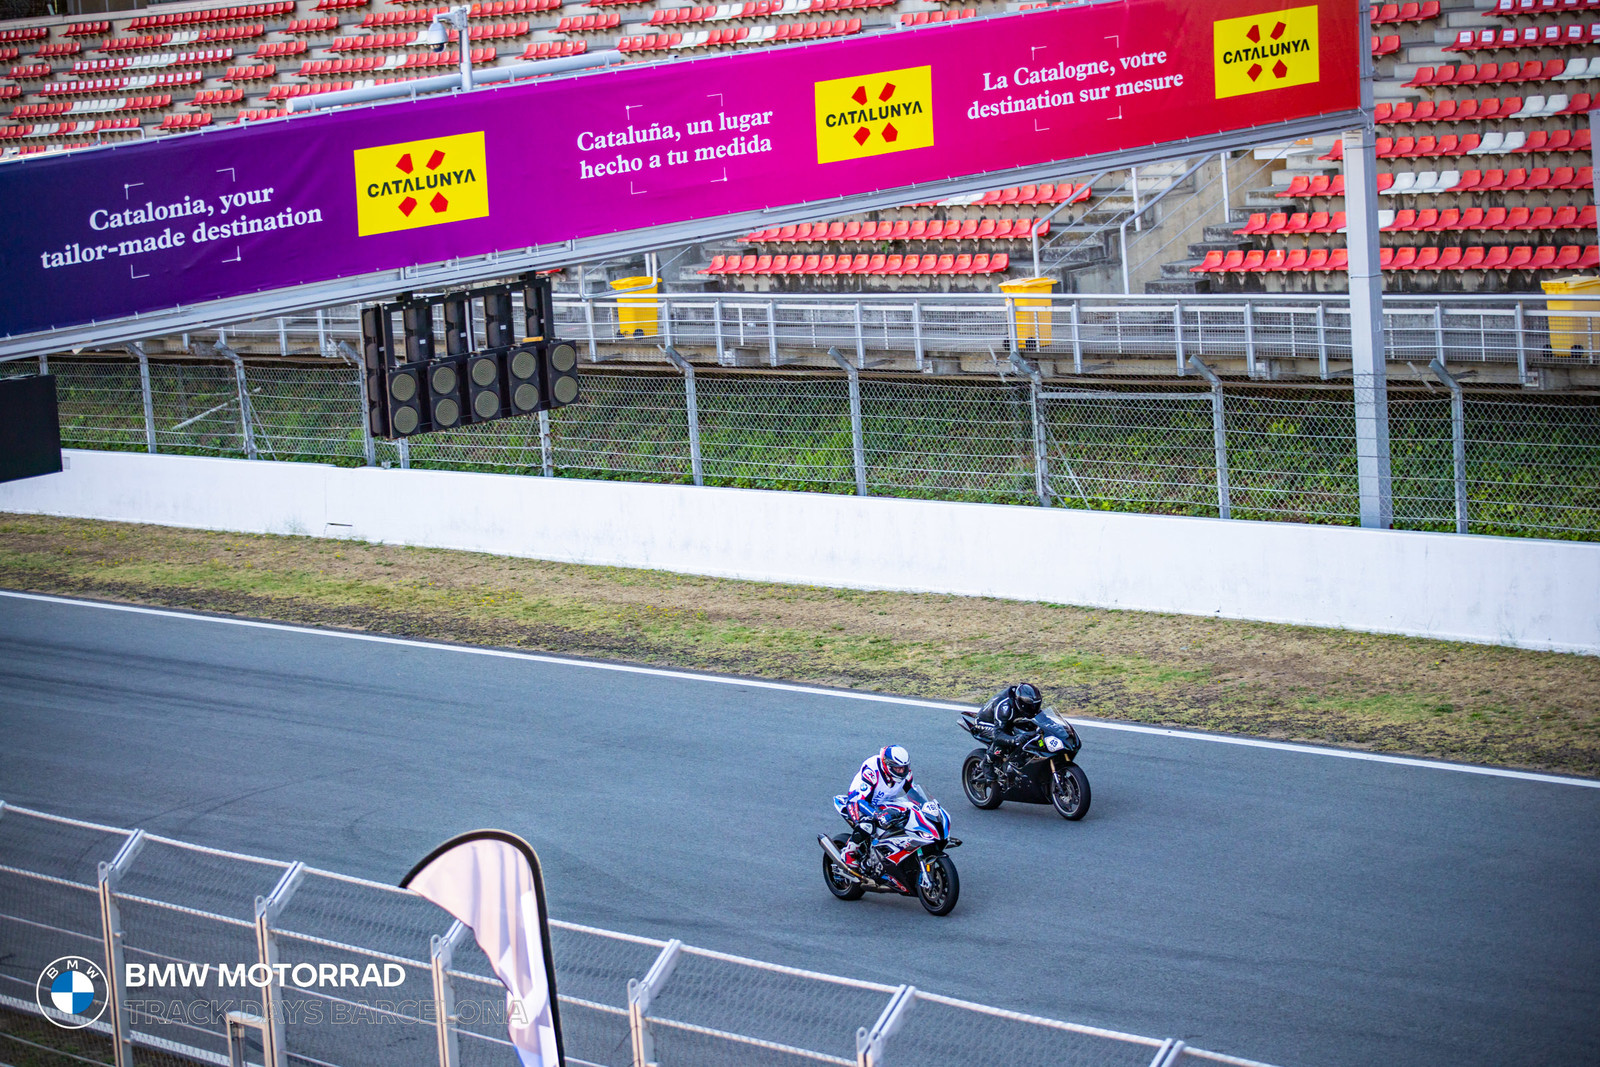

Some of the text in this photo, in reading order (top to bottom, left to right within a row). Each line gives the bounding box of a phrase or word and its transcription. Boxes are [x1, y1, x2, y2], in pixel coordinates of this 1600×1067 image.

[983, 50, 1167, 92] La Catalogne, votre
[1223, 38, 1310, 65] CATALUNYA
[825, 100, 923, 128] CATALUNYA
[967, 73, 1184, 120] destination sur mesure
[577, 110, 774, 152] Cataluña, un lugar
[579, 134, 773, 180] hecho a tu medida
[367, 168, 476, 198] CATALUNYA
[89, 187, 275, 232] Catalonia, your
[41, 207, 323, 270] tailor-made destination
